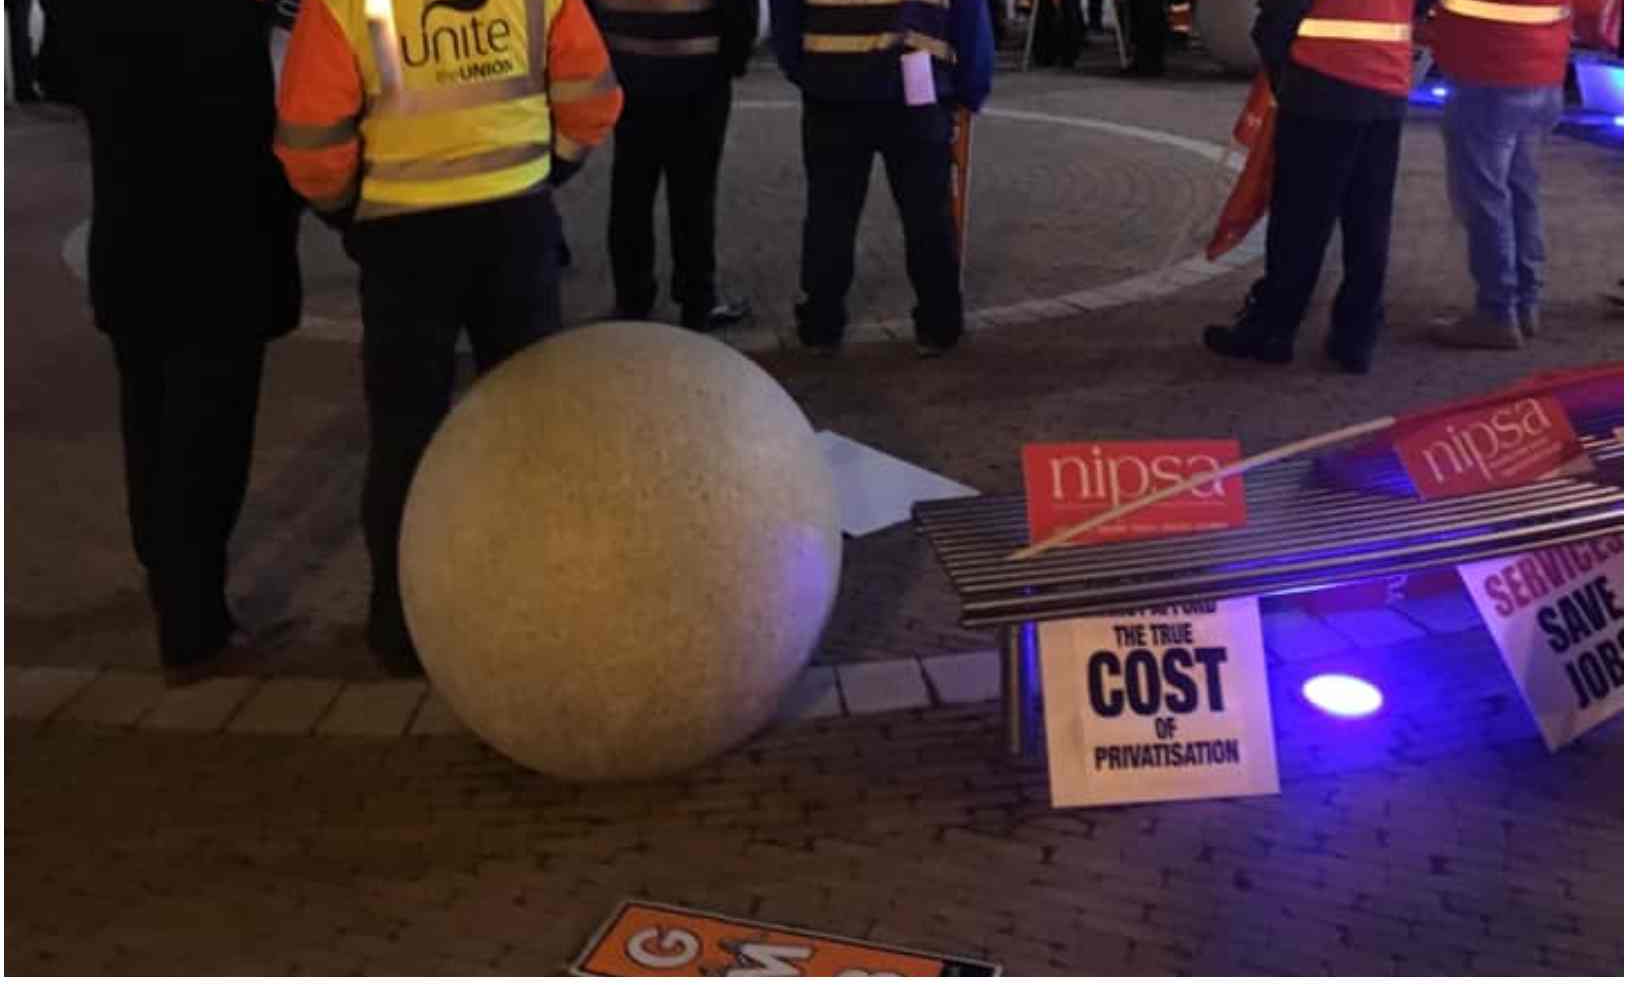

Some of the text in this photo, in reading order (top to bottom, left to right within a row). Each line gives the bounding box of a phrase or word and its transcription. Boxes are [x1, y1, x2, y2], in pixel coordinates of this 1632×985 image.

[400, 16, 510, 67] unite
[1421, 396, 1554, 483] nipsa
[1049, 445, 1226, 508] nipsa
[1113, 622, 1193, 647] THE TRUE
[1537, 575, 1624, 654] SAVE
[1088, 646, 1228, 717] COST
[1093, 739, 1240, 771] PRIVATISATION
[1154, 717, 1178, 740] OF
